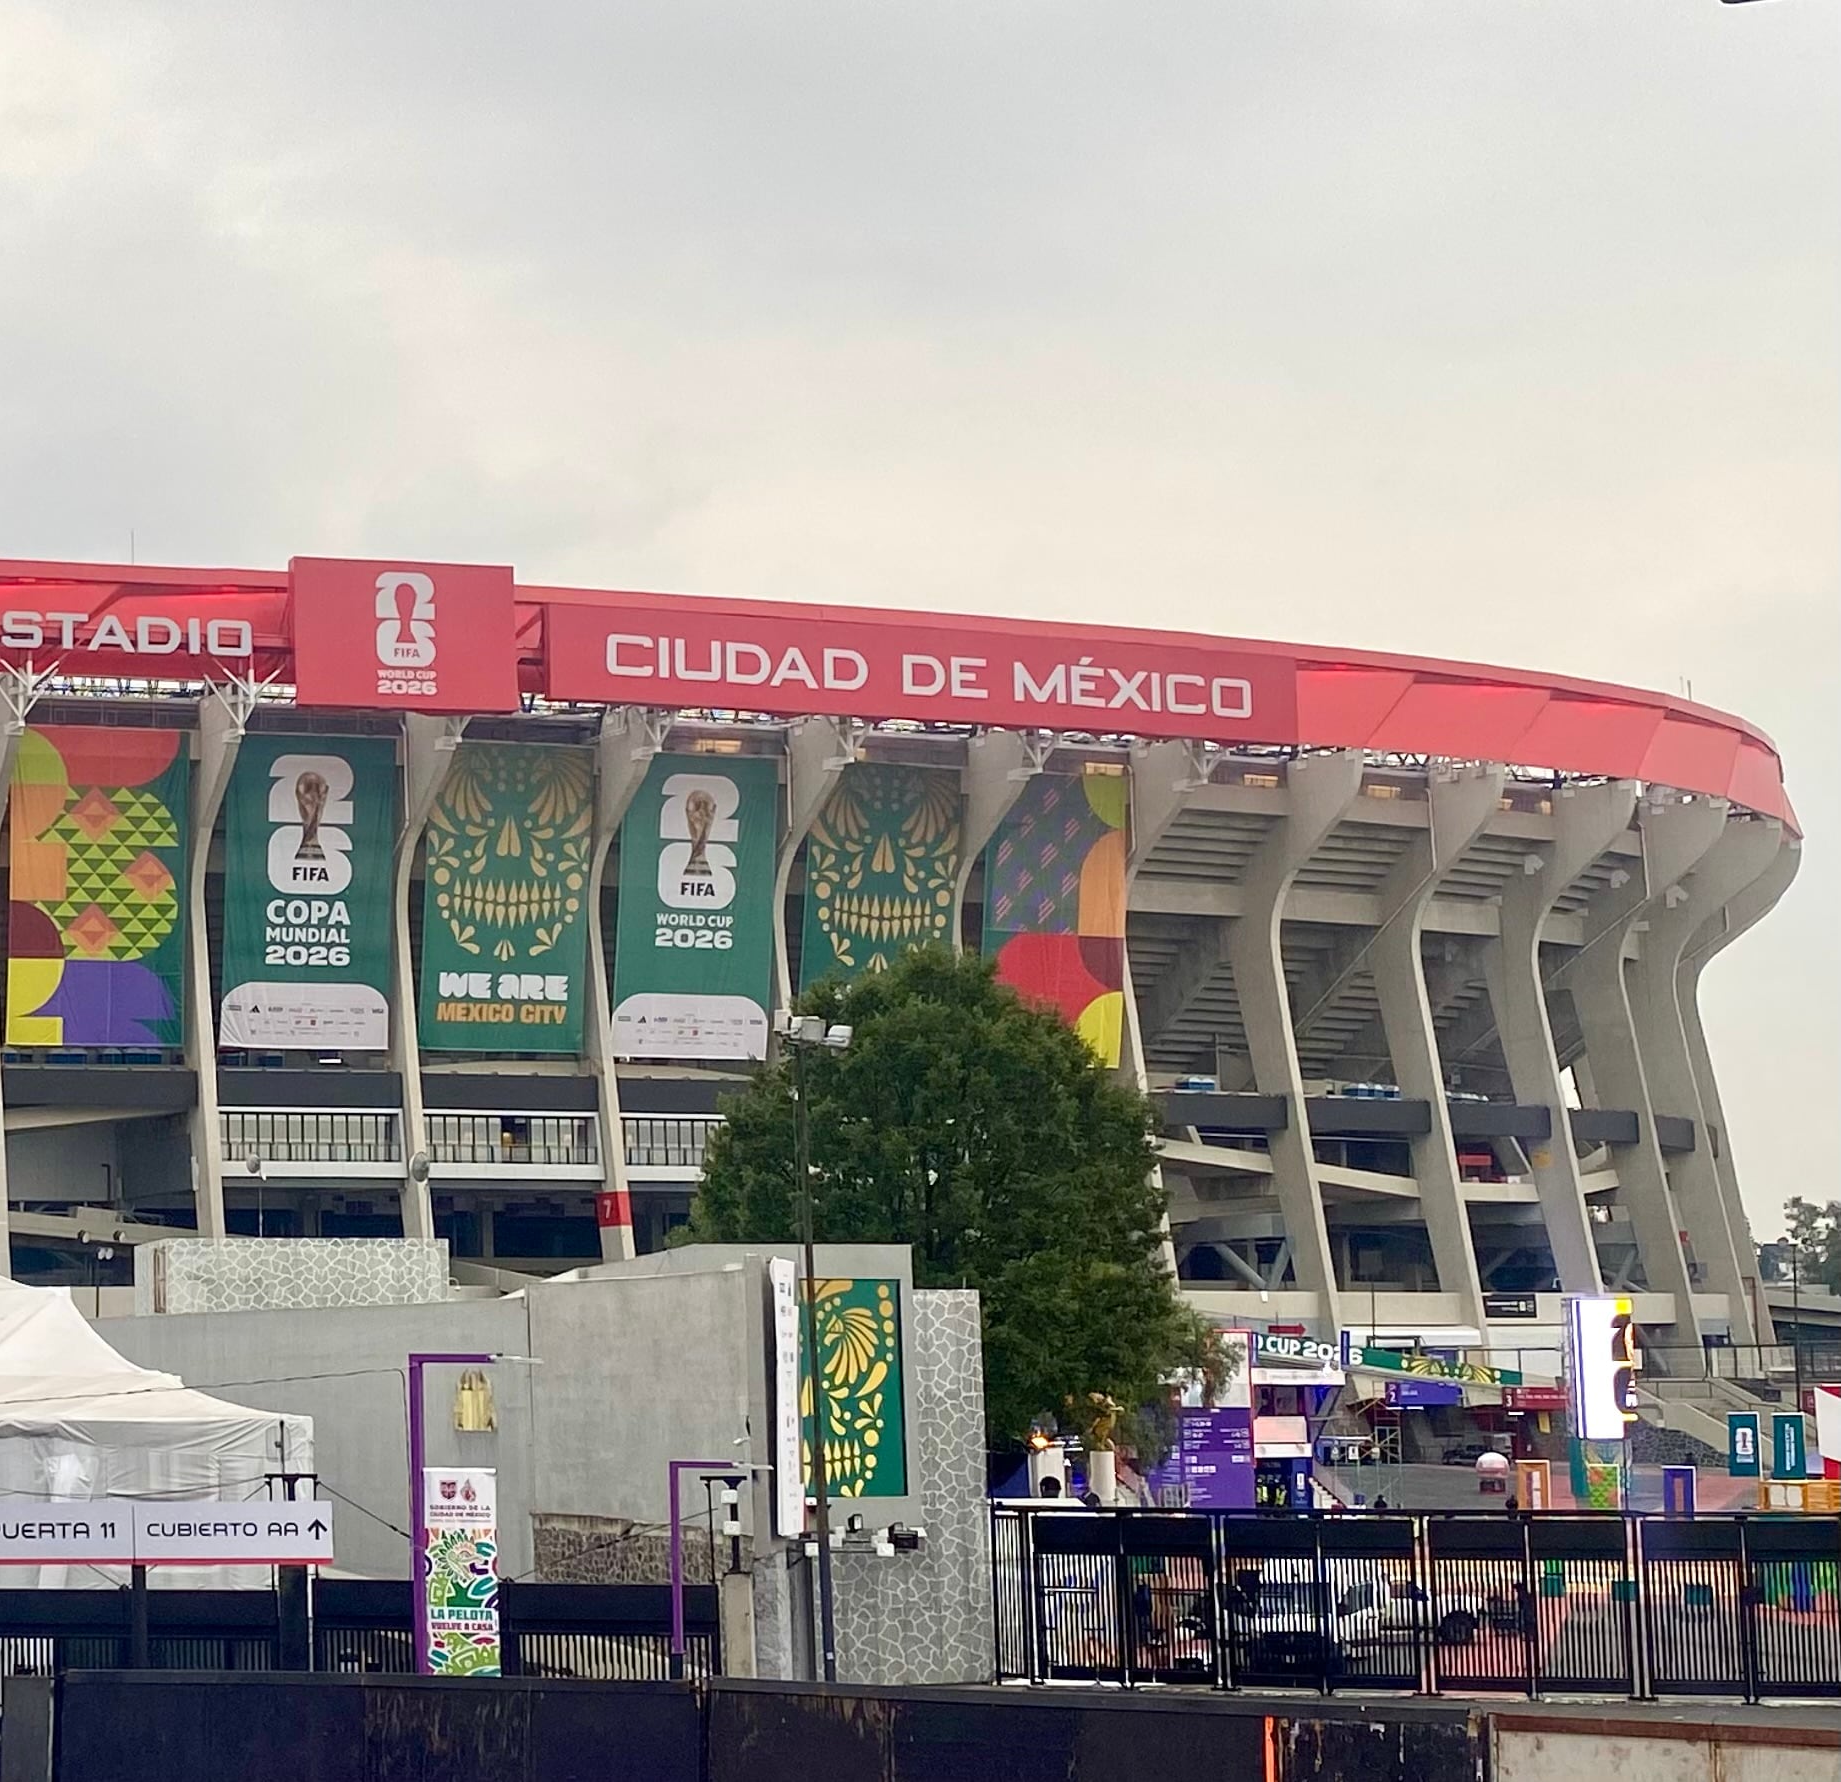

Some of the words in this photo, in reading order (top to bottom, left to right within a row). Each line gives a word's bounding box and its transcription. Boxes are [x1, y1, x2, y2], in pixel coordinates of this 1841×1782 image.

[393, 648, 420, 658] FIFA
[377, 669, 415, 680] WORLD
[416, 670, 437, 680] CUP
[605, 633, 868, 691] CIUDAD
[902, 653, 988, 699] DE
[1014, 656, 1253, 719] MÉXICO
[377, 680, 438, 696] 2026
[292, 867, 329, 882] FIFA
[680, 882, 715, 897] FIFA
[266, 900, 351, 926] COPA
[656, 913, 705, 926] WORLD
[707, 915, 733, 927] CUP
[265, 928, 350, 944] MUNDIAL
[655, 928, 733, 949] 2026
[265, 945, 350, 966] 2026
[438, 972, 492, 999] WE
[497, 973, 569, 1001] ARE
[437, 1002, 514, 1024] MEXICO
[519, 1003, 567, 1025] CITY
[1265, 1336, 1301, 1354] CUP
[100, 1522, 116, 1539] 11
[146, 1522, 258, 1537] CUBIERTO
[267, 1522, 299, 1537] AA
[431, 1609, 445, 1620] LA
[448, 1609, 493, 1621] PELOTA
[431, 1622, 462, 1630] VUELVE
[471, 1623, 494, 1631] CASA
